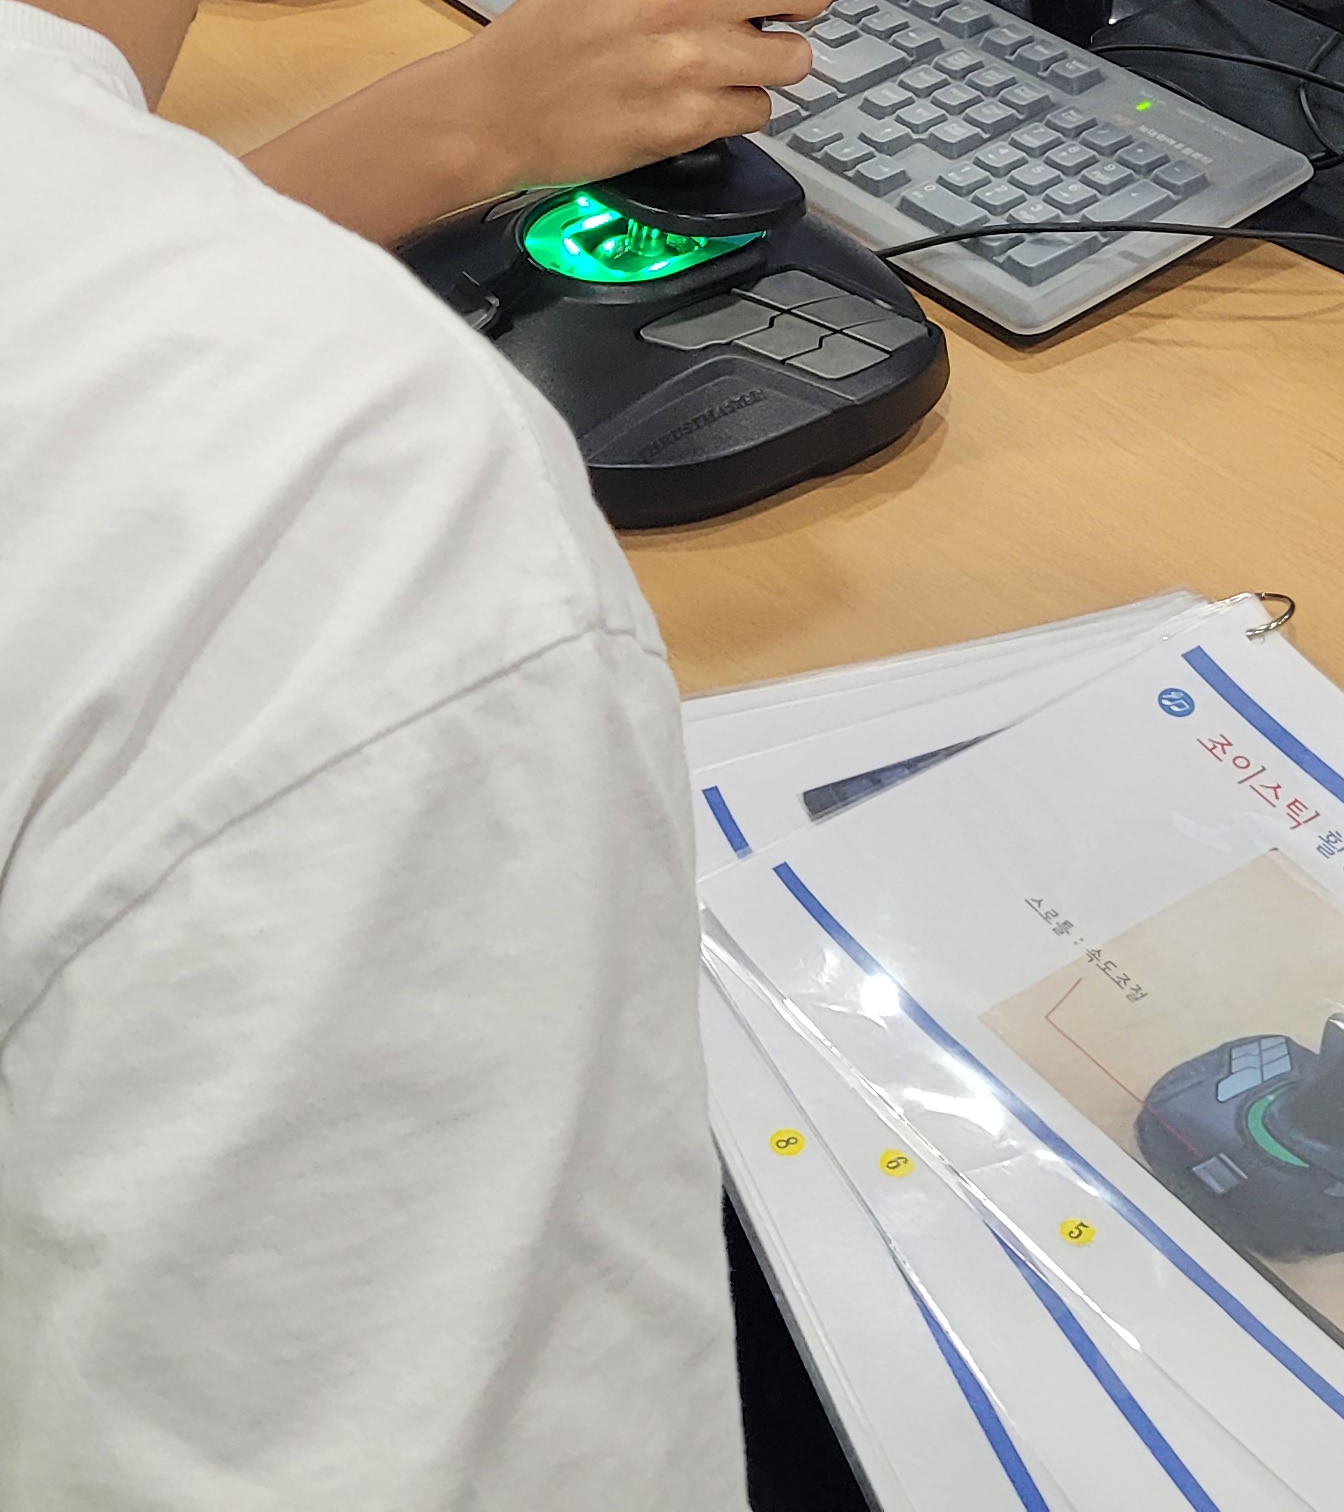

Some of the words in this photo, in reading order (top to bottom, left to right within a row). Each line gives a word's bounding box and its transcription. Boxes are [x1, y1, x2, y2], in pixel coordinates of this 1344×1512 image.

[1196, 733, 1321, 830] 조이스틱
[1024, 897, 1074, 936] 스로틀
[1085, 949, 1149, 1003] 속도조절
[774, 1135, 799, 1150] 8
[1068, 1220, 1091, 1241] 5
